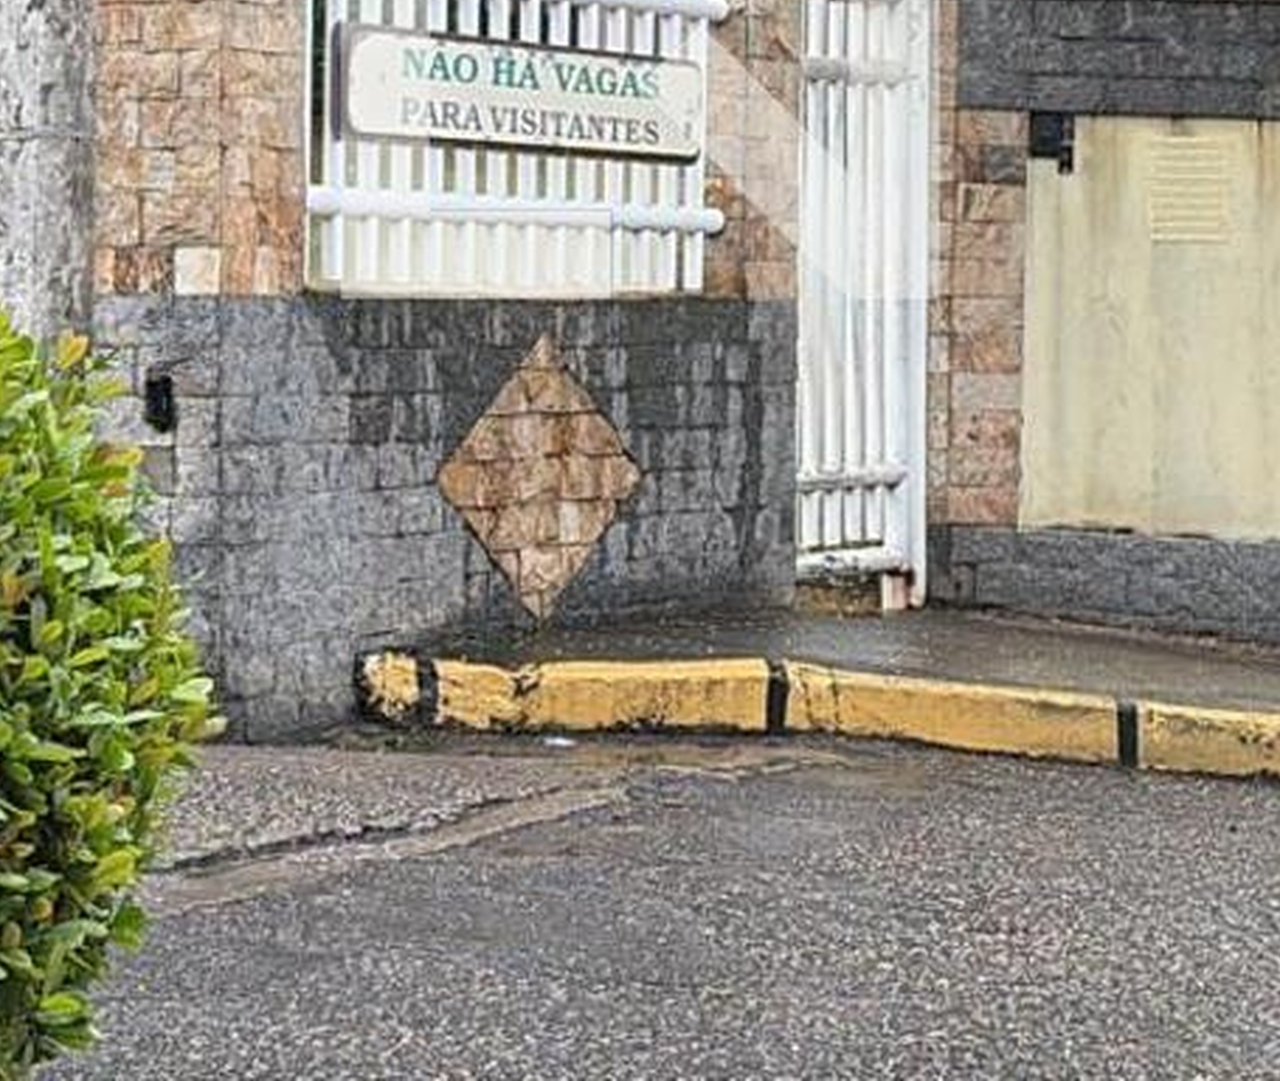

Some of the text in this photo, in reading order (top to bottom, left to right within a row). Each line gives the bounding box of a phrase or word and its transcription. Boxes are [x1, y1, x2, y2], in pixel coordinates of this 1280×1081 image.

[554, 63, 660, 99] VAGAS
[401, 98, 661, 145] PARA VISITANTES
